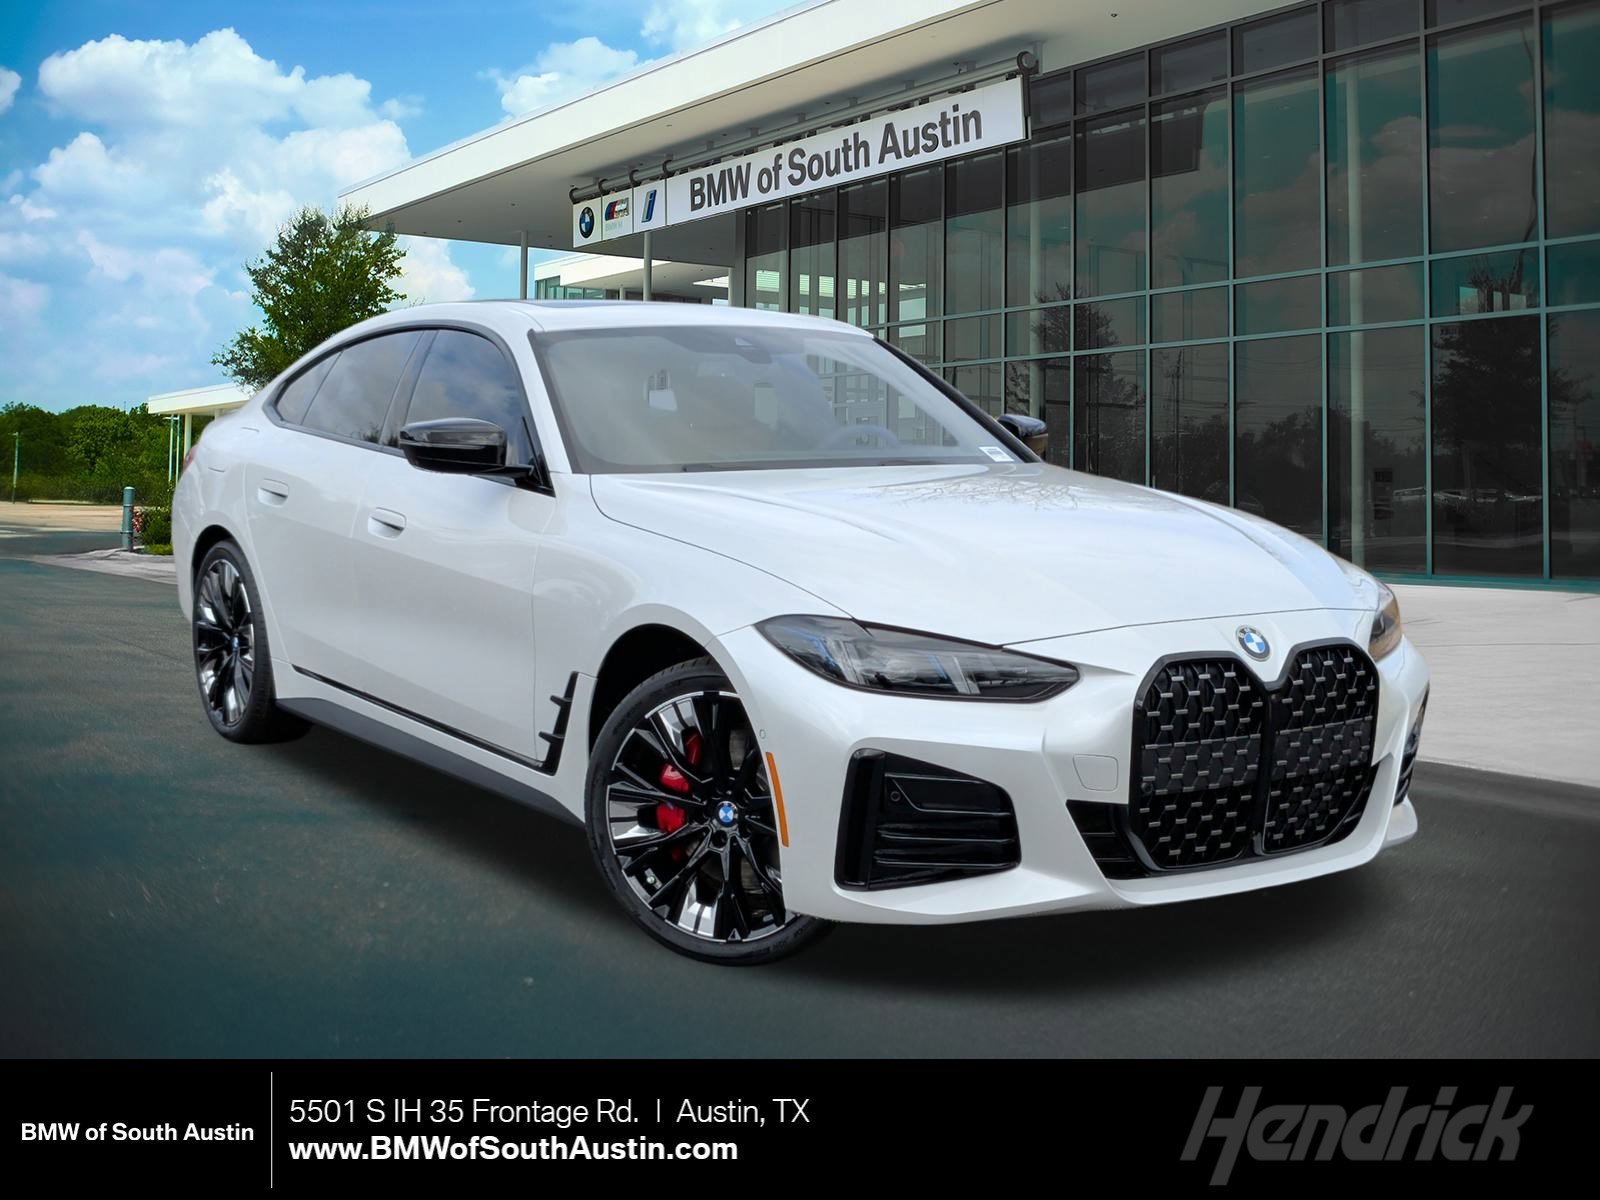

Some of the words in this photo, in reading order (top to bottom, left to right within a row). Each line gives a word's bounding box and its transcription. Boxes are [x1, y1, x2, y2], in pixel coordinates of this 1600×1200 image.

[690, 162, 751, 212] BMW
[757, 153, 783, 194] of
[787, 132, 870, 187] South
[878, 104, 982, 164] Austin
